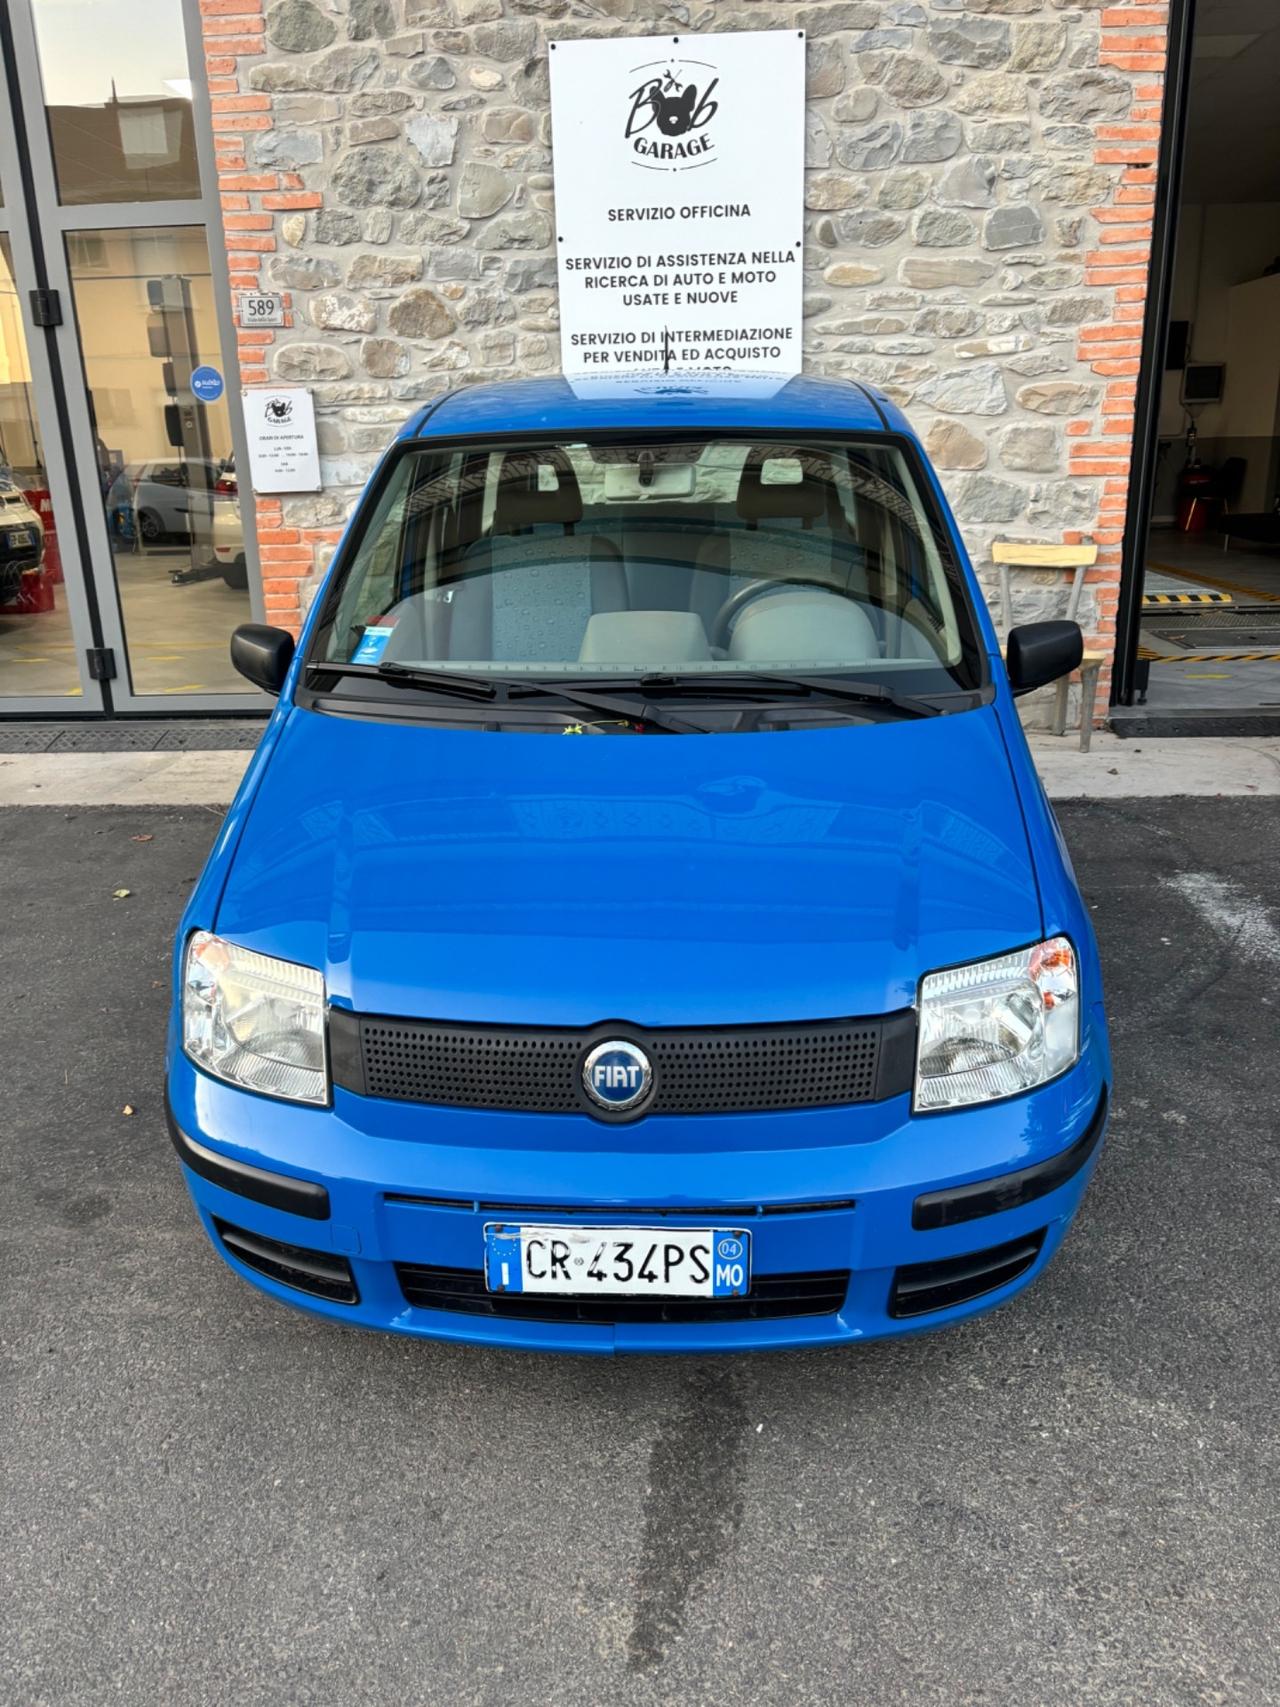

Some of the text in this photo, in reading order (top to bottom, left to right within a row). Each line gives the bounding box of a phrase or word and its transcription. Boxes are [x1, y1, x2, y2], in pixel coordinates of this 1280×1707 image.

[633, 133, 715, 160] GARAGE
[609, 204, 750, 221] SERVIZIO OFFICINA
[566, 251, 795, 270] SERVIZIO DI ASSISTENZA NELLA
[585, 271, 776, 288] RICERCA DI AUTO E MOTO
[623, 291, 737, 305] USATE E NUOVE
[248, 299, 274, 316] 589
[571, 327, 793, 345] SERVIZIO DI INTERMEDIAZIONE
[584, 347, 780, 363] PER VENDITA ED ACQUISTO
[594, 1065, 639, 1088] FIAT
[526, 1239, 571, 1280] CR
[587, 1241, 710, 1284] 434PS
[720, 1243, 738, 1256] 04
[716, 1264, 743, 1287] MO
